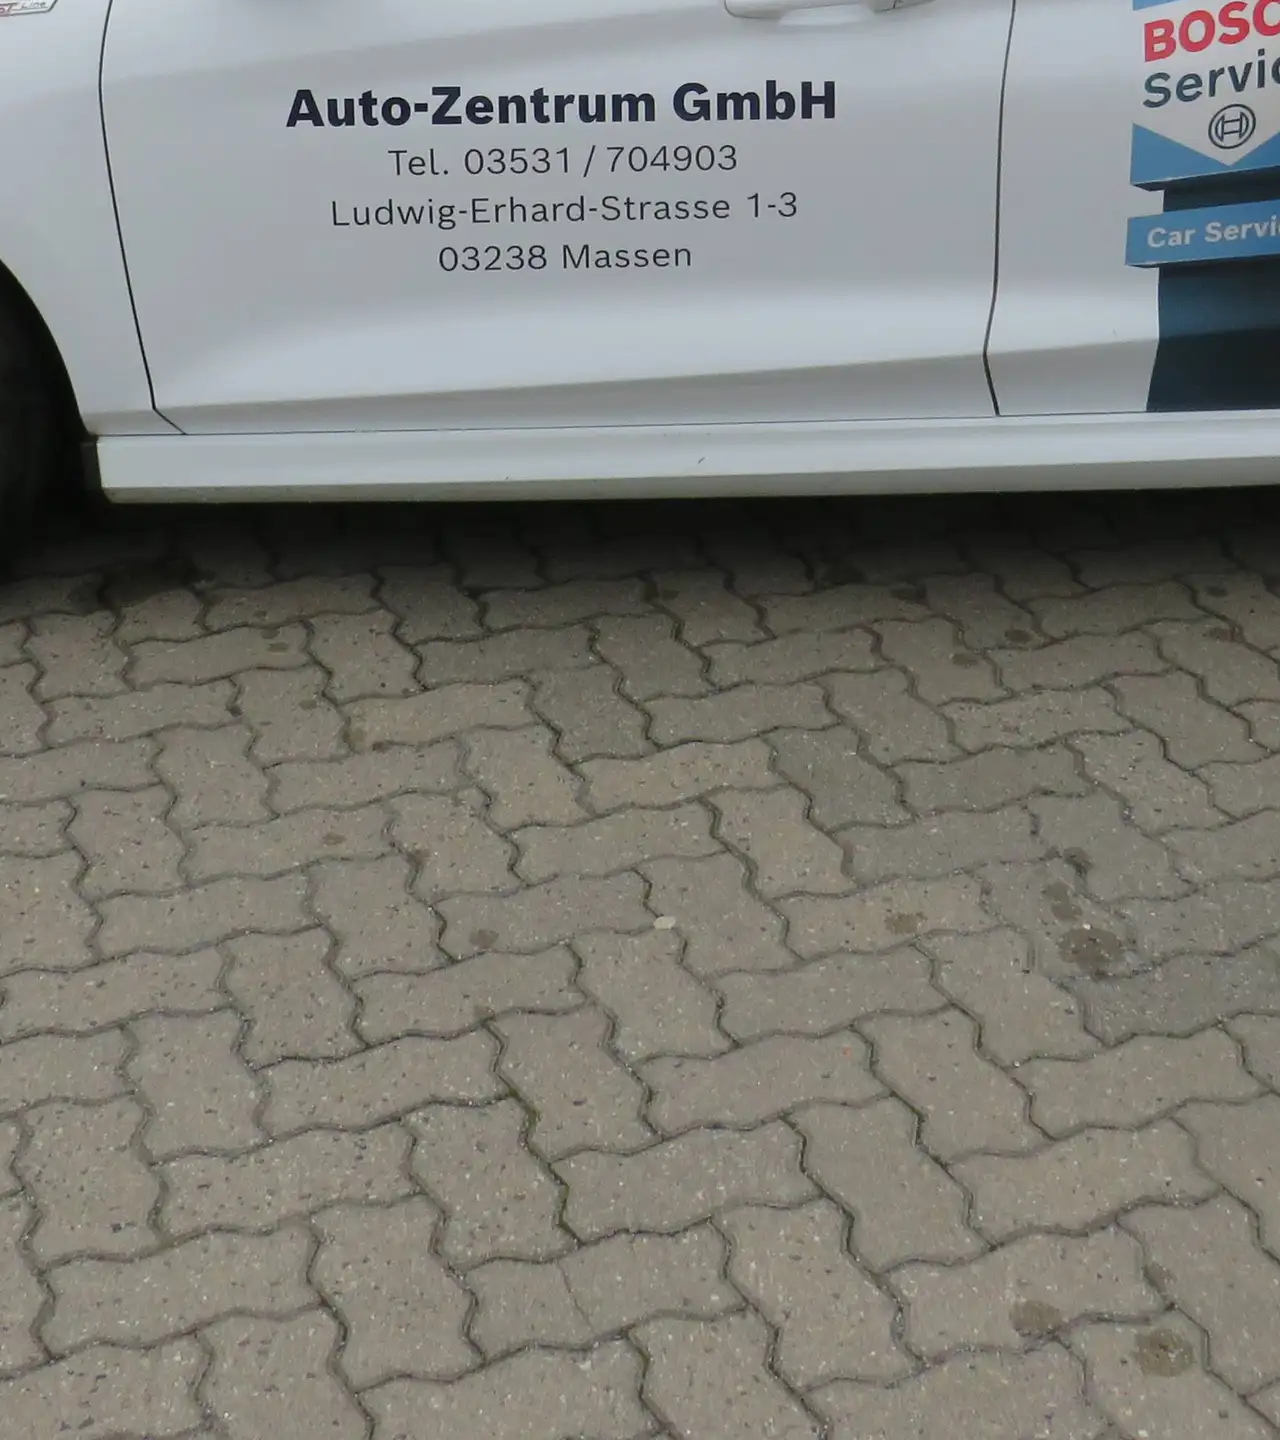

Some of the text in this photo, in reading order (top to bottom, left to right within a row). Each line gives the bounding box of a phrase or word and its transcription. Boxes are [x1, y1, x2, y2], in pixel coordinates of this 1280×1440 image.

[285, 80, 838, 128] Auto-Zentrum GmbH
[388, 148, 450, 177] Tel.
[464, 147, 570, 176] 03531
[607, 144, 738, 174] 704903
[331, 192, 799, 231] Ludwig-Erhard-Strasse 1-3
[1147, 227, 1196, 249] Car
[438, 243, 693, 273] 03238 Massen
